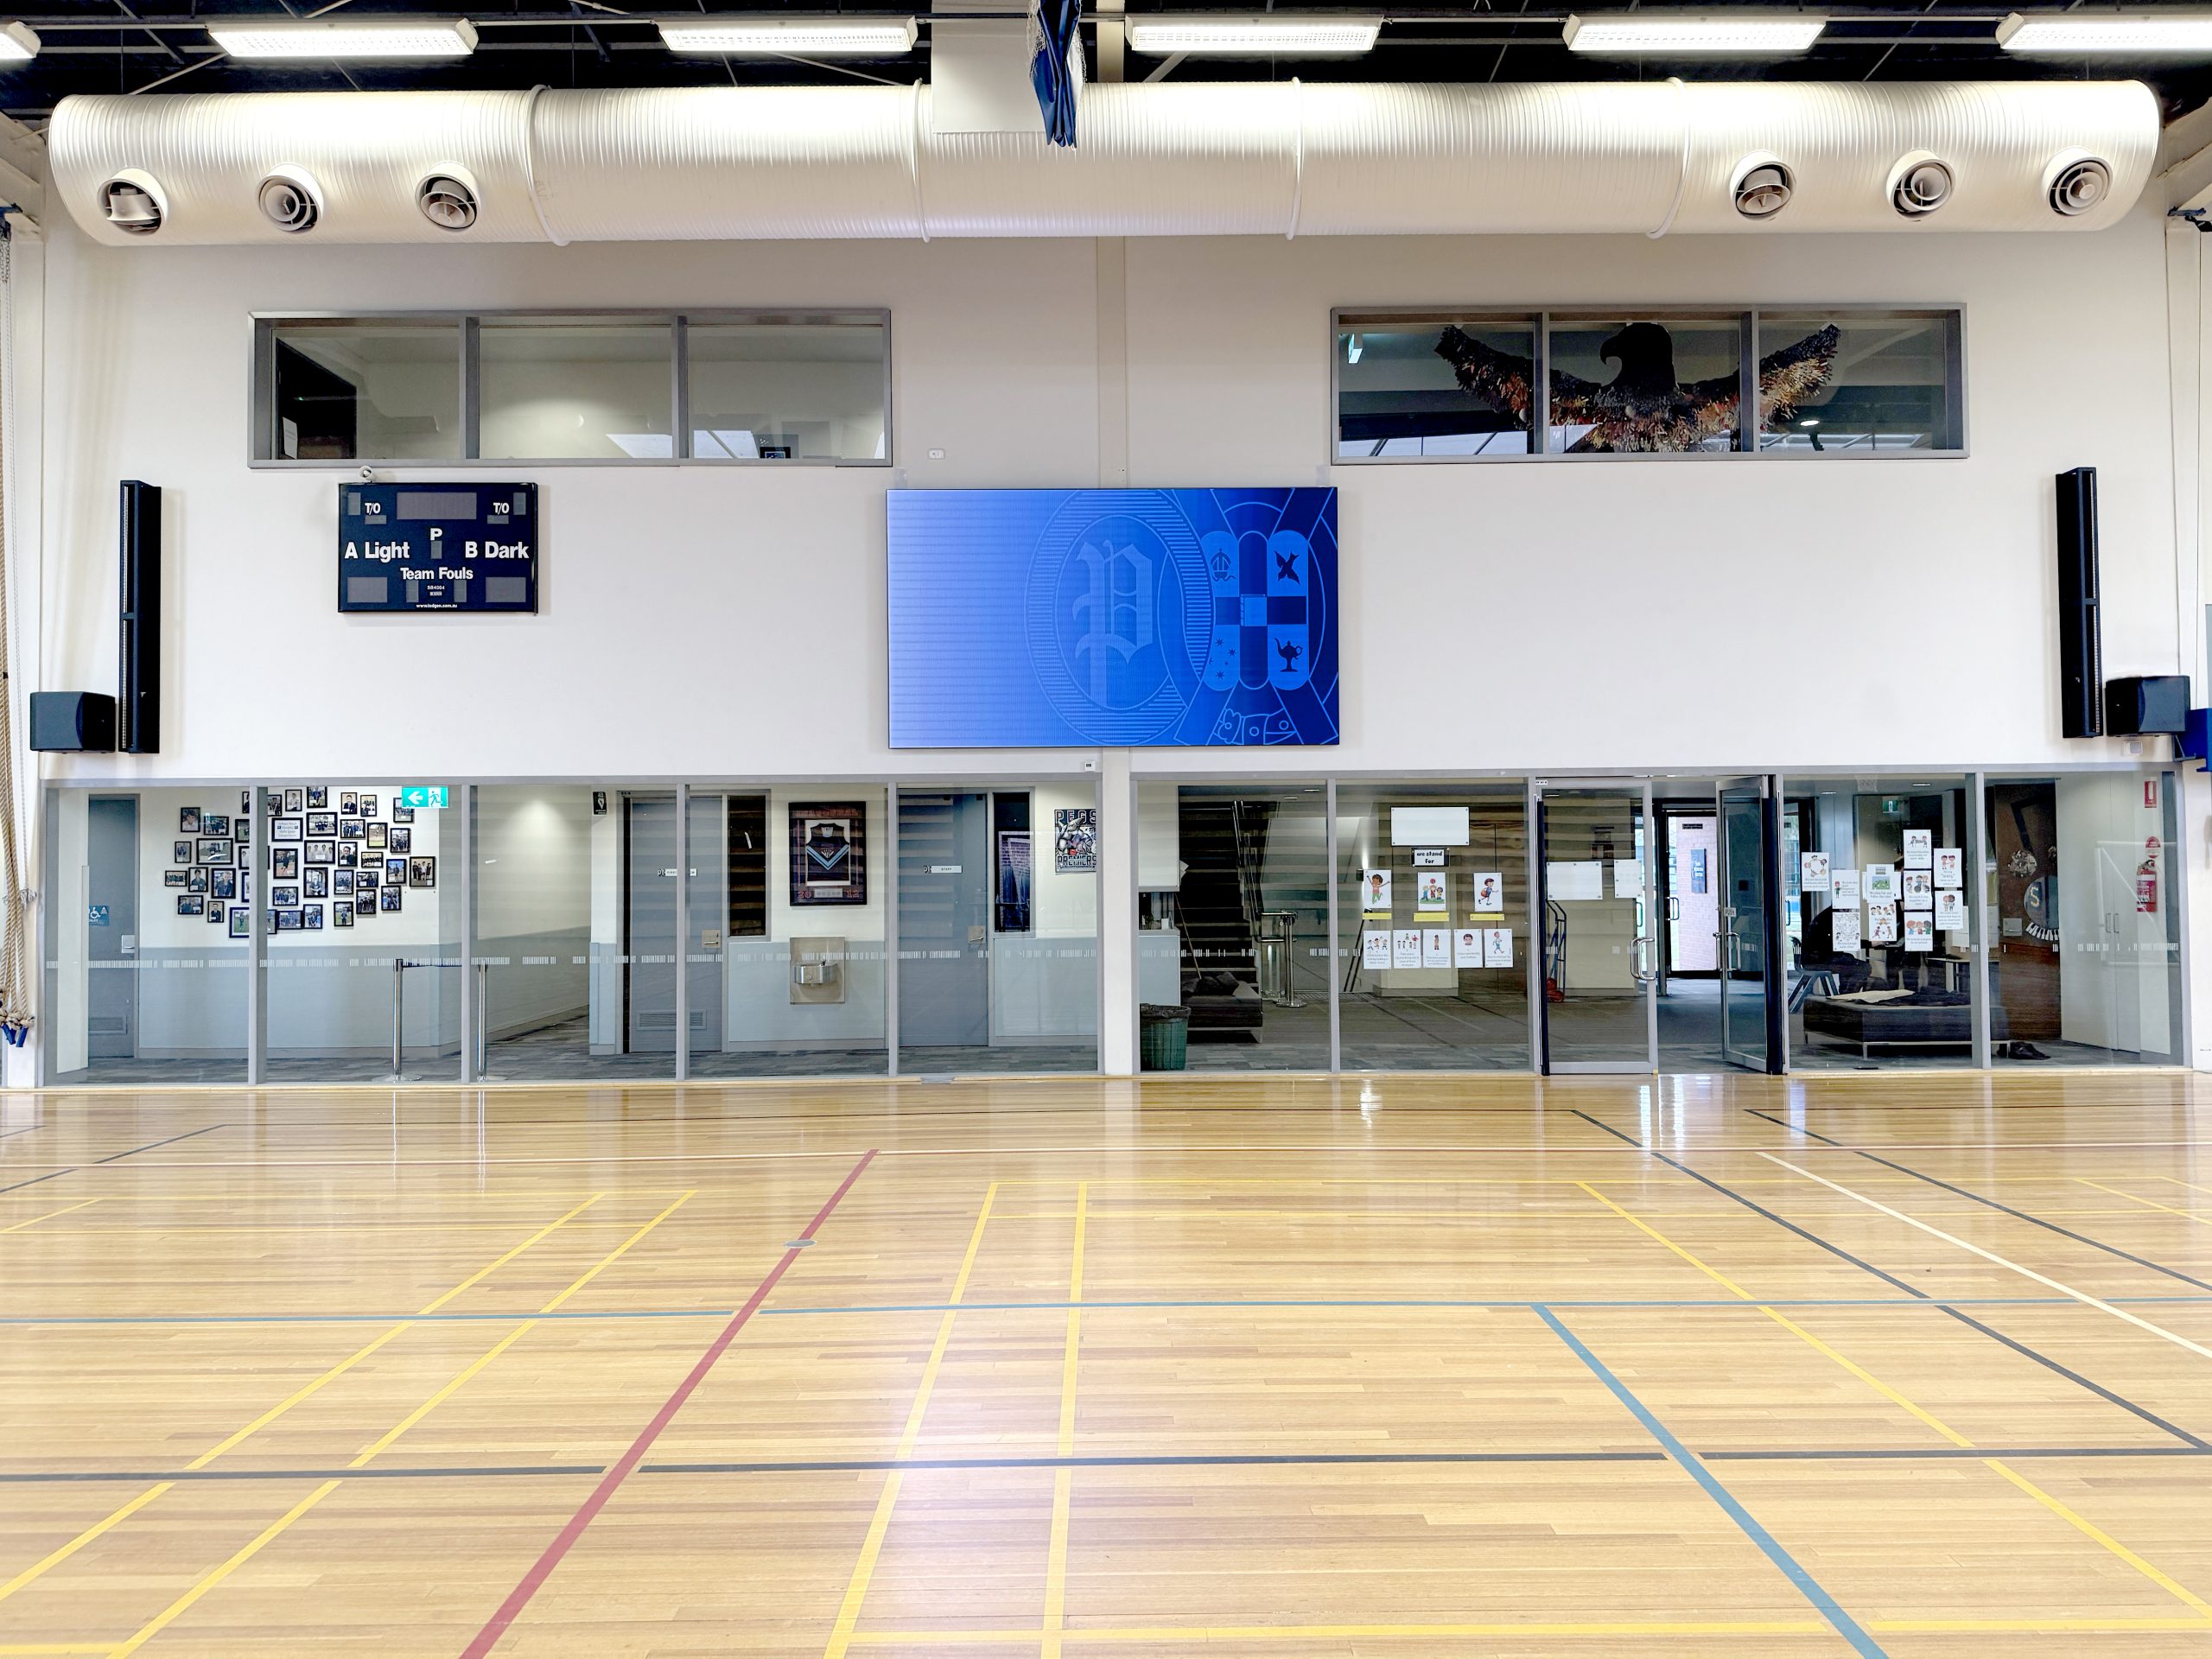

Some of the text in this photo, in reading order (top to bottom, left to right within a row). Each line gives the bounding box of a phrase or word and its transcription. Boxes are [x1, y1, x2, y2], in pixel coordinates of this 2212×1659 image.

[365, 503, 381, 514] T/O
[493, 503, 510, 514] T/O
[430, 528, 442, 540] P
[345, 542, 410, 563] A Light
[465, 542, 530, 559] B Dark
[400, 567, 474, 580] Team Fouls
[1055, 810, 1096, 823] PEGS
[1057, 855, 1096, 866] PREMIERS
